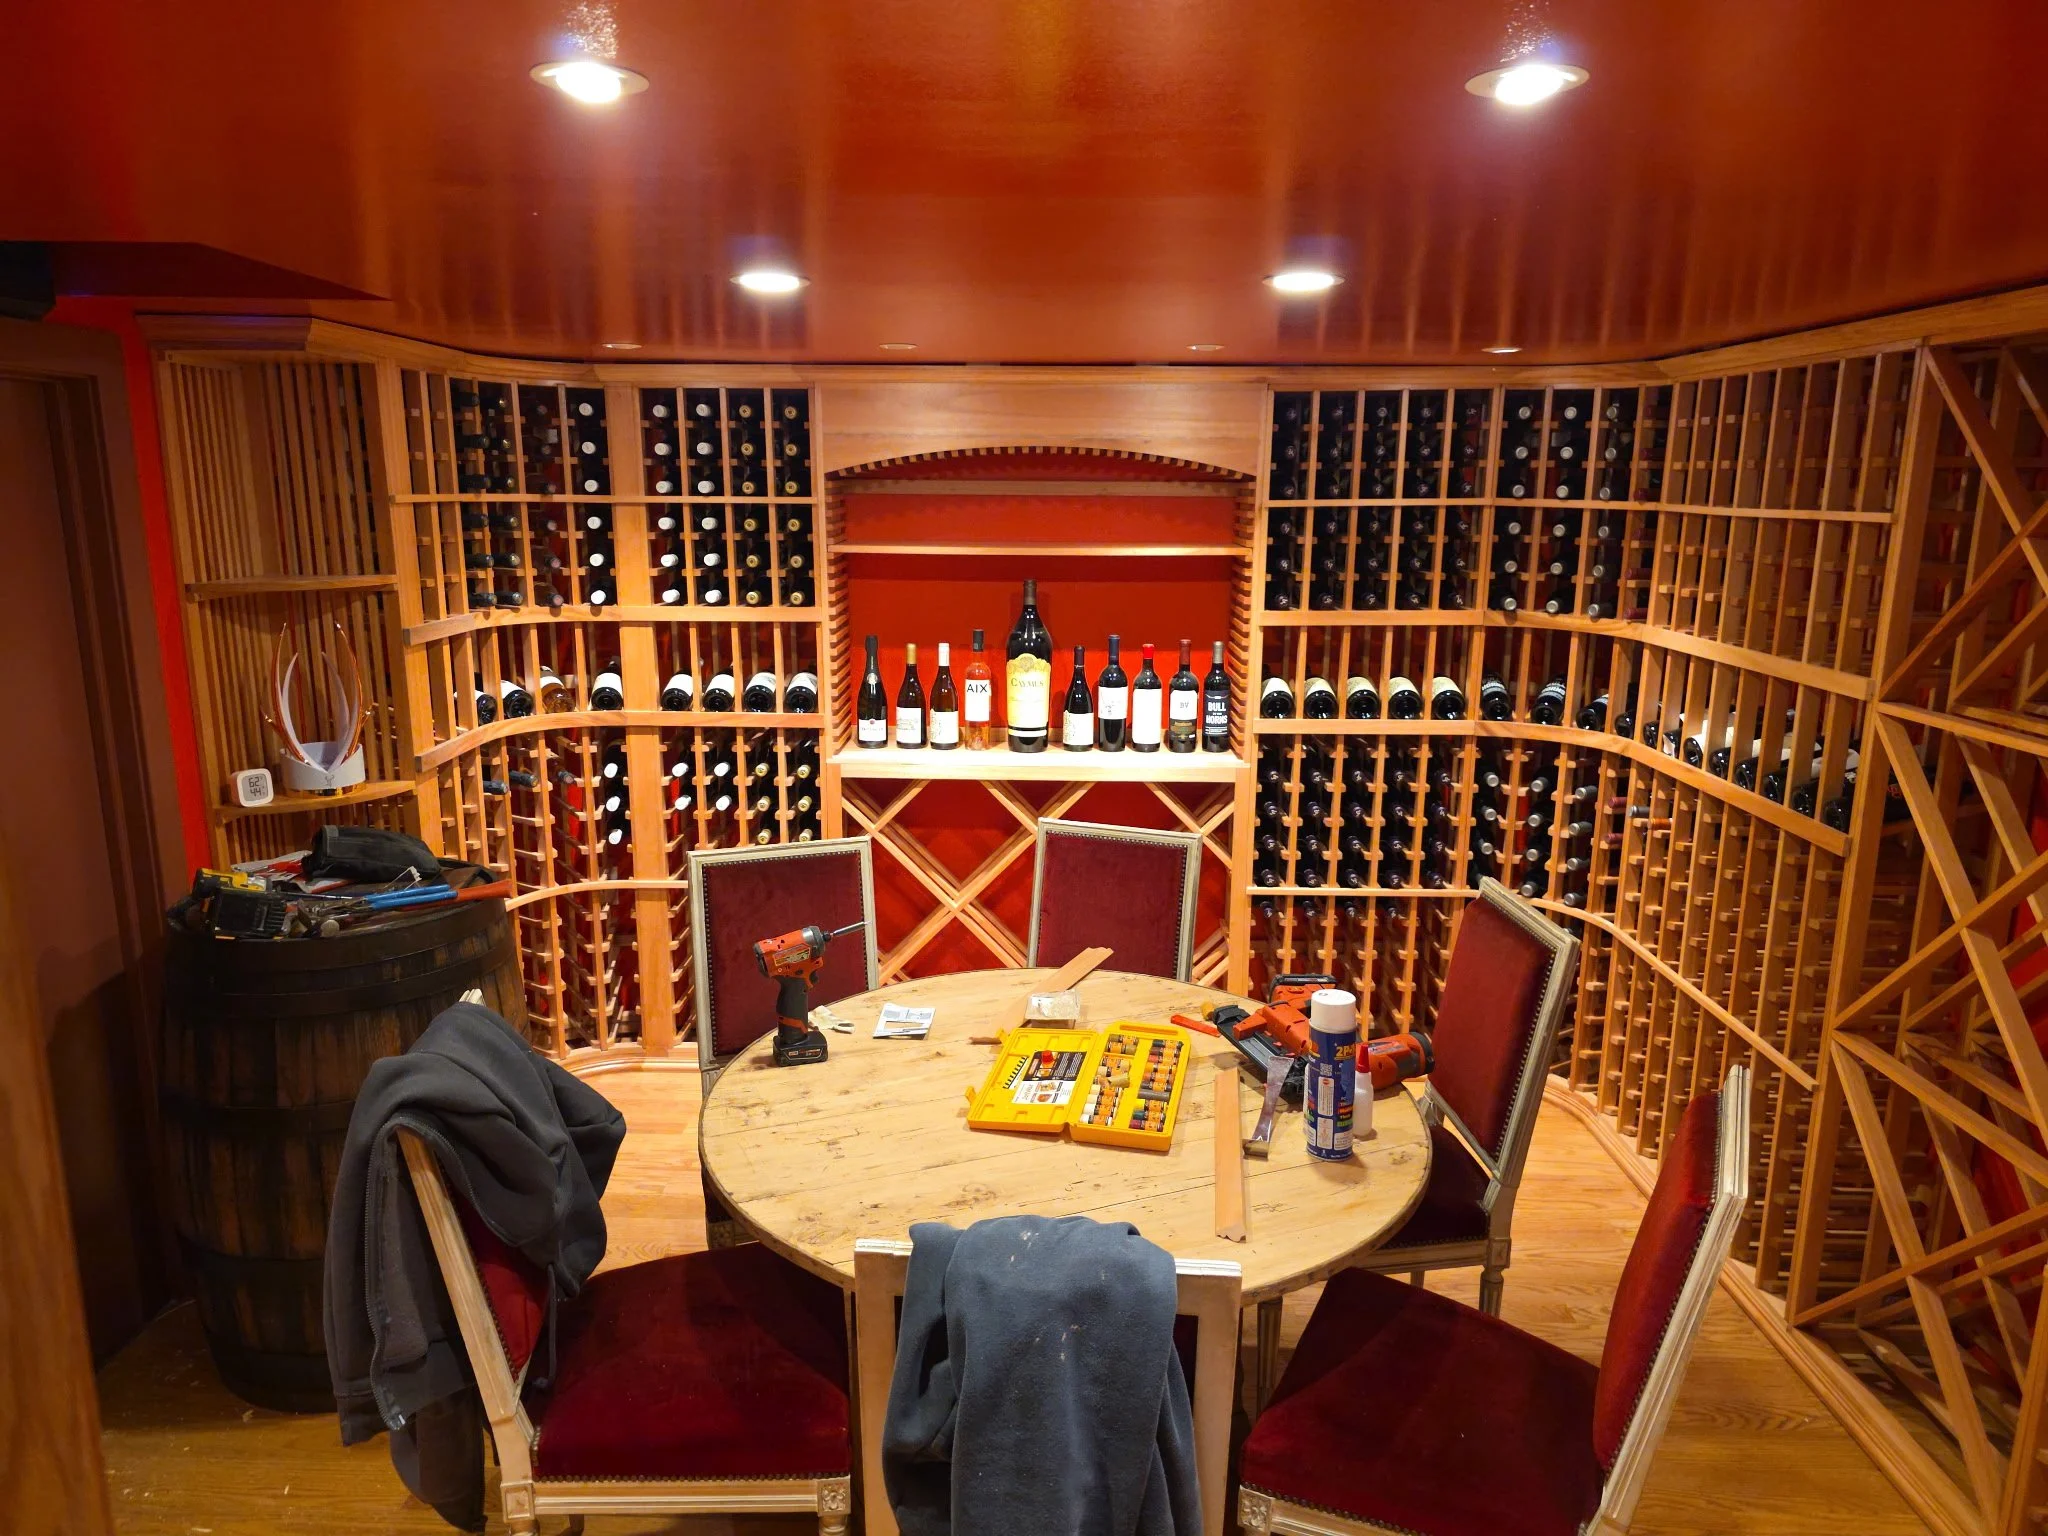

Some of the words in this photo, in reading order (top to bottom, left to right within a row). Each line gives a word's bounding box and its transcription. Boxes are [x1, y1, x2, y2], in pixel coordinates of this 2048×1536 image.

[1011, 678, 1044, 687] CAYMUS
[967, 683, 988, 694] AIX
[1207, 702, 1226, 711] BULL
[1206, 715, 1228, 724] HORNS
[249, 777, 260, 787] 62
[250, 788, 261, 797] 44
